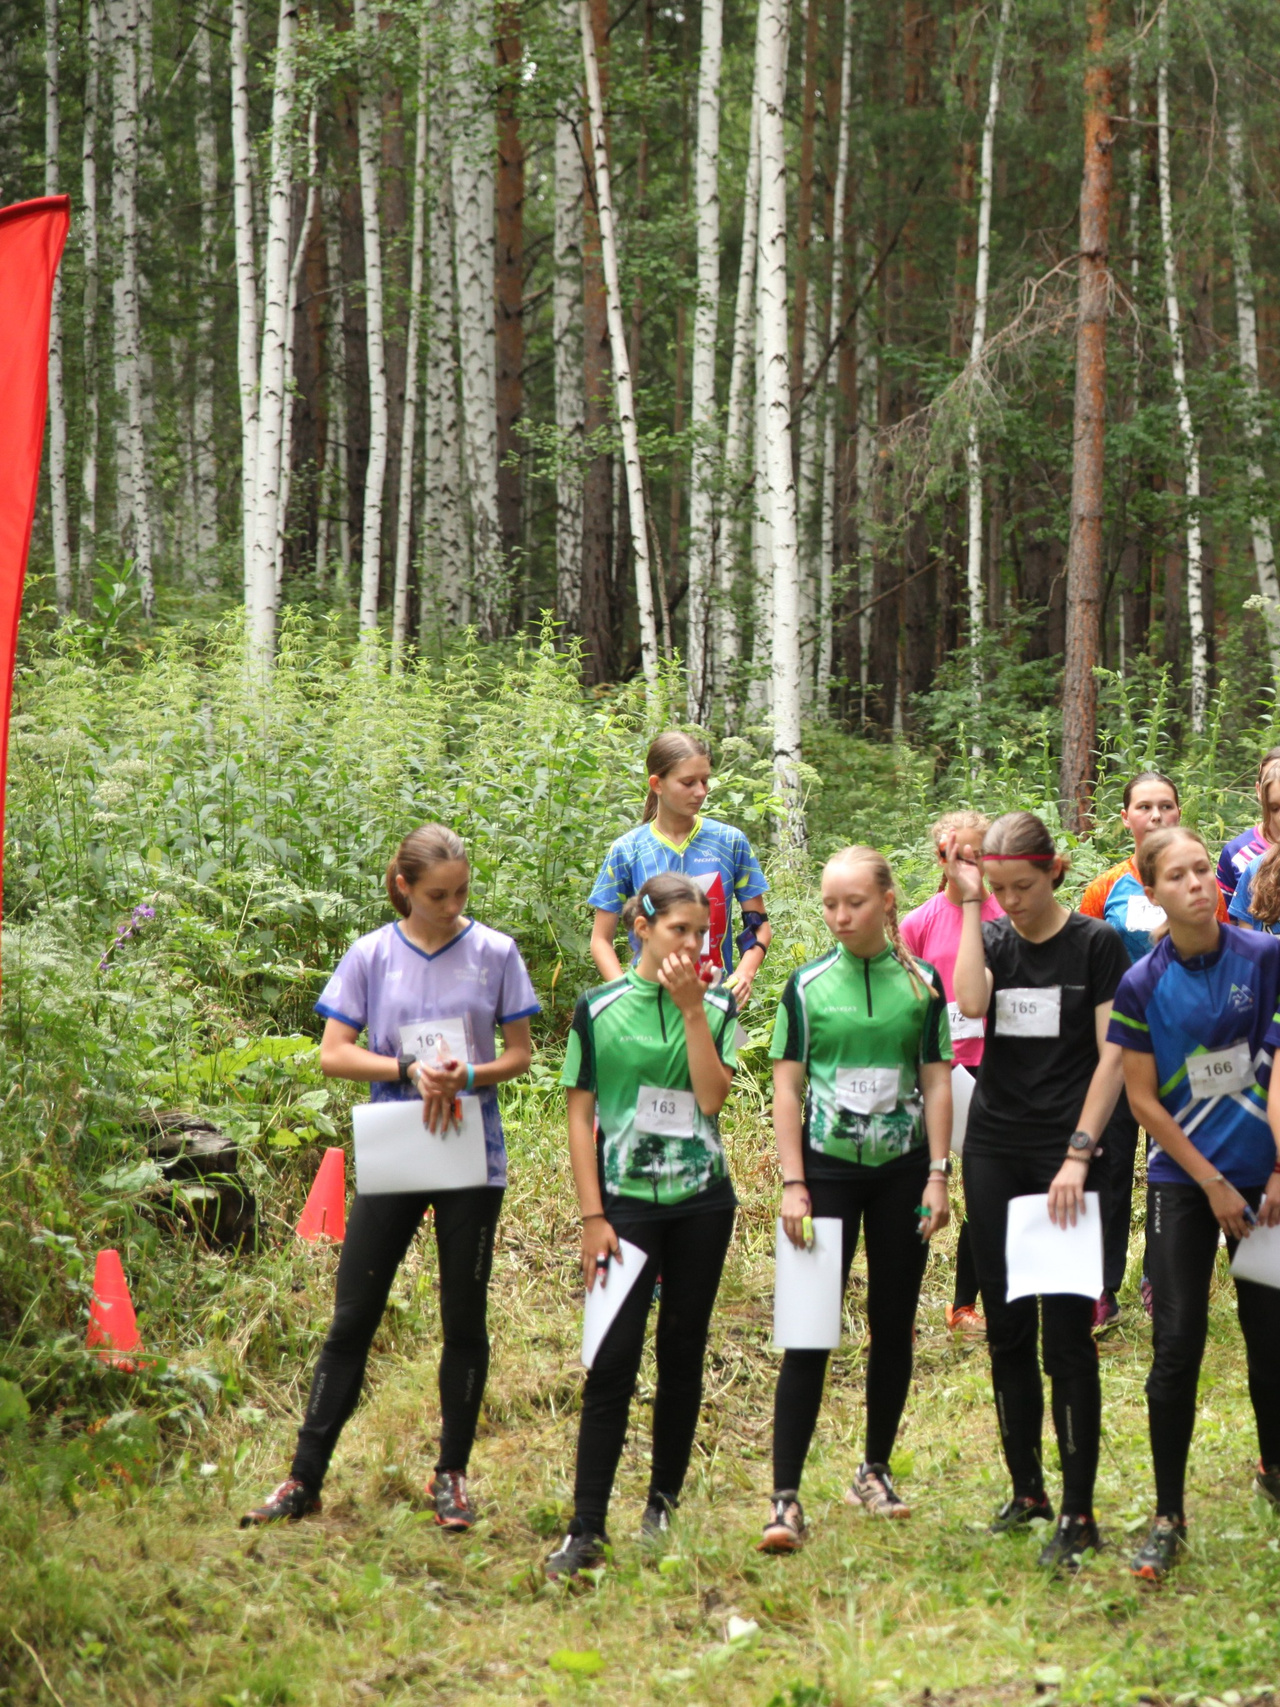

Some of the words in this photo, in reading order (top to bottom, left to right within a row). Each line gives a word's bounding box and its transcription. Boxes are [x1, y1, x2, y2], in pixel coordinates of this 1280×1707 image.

[1010, 1001, 1037, 1014] 165
[950, 1012, 965, 1022] 72
[1204, 1061, 1233, 1077] 166
[850, 1080, 877, 1094] 164
[651, 1099, 676, 1115] 163
